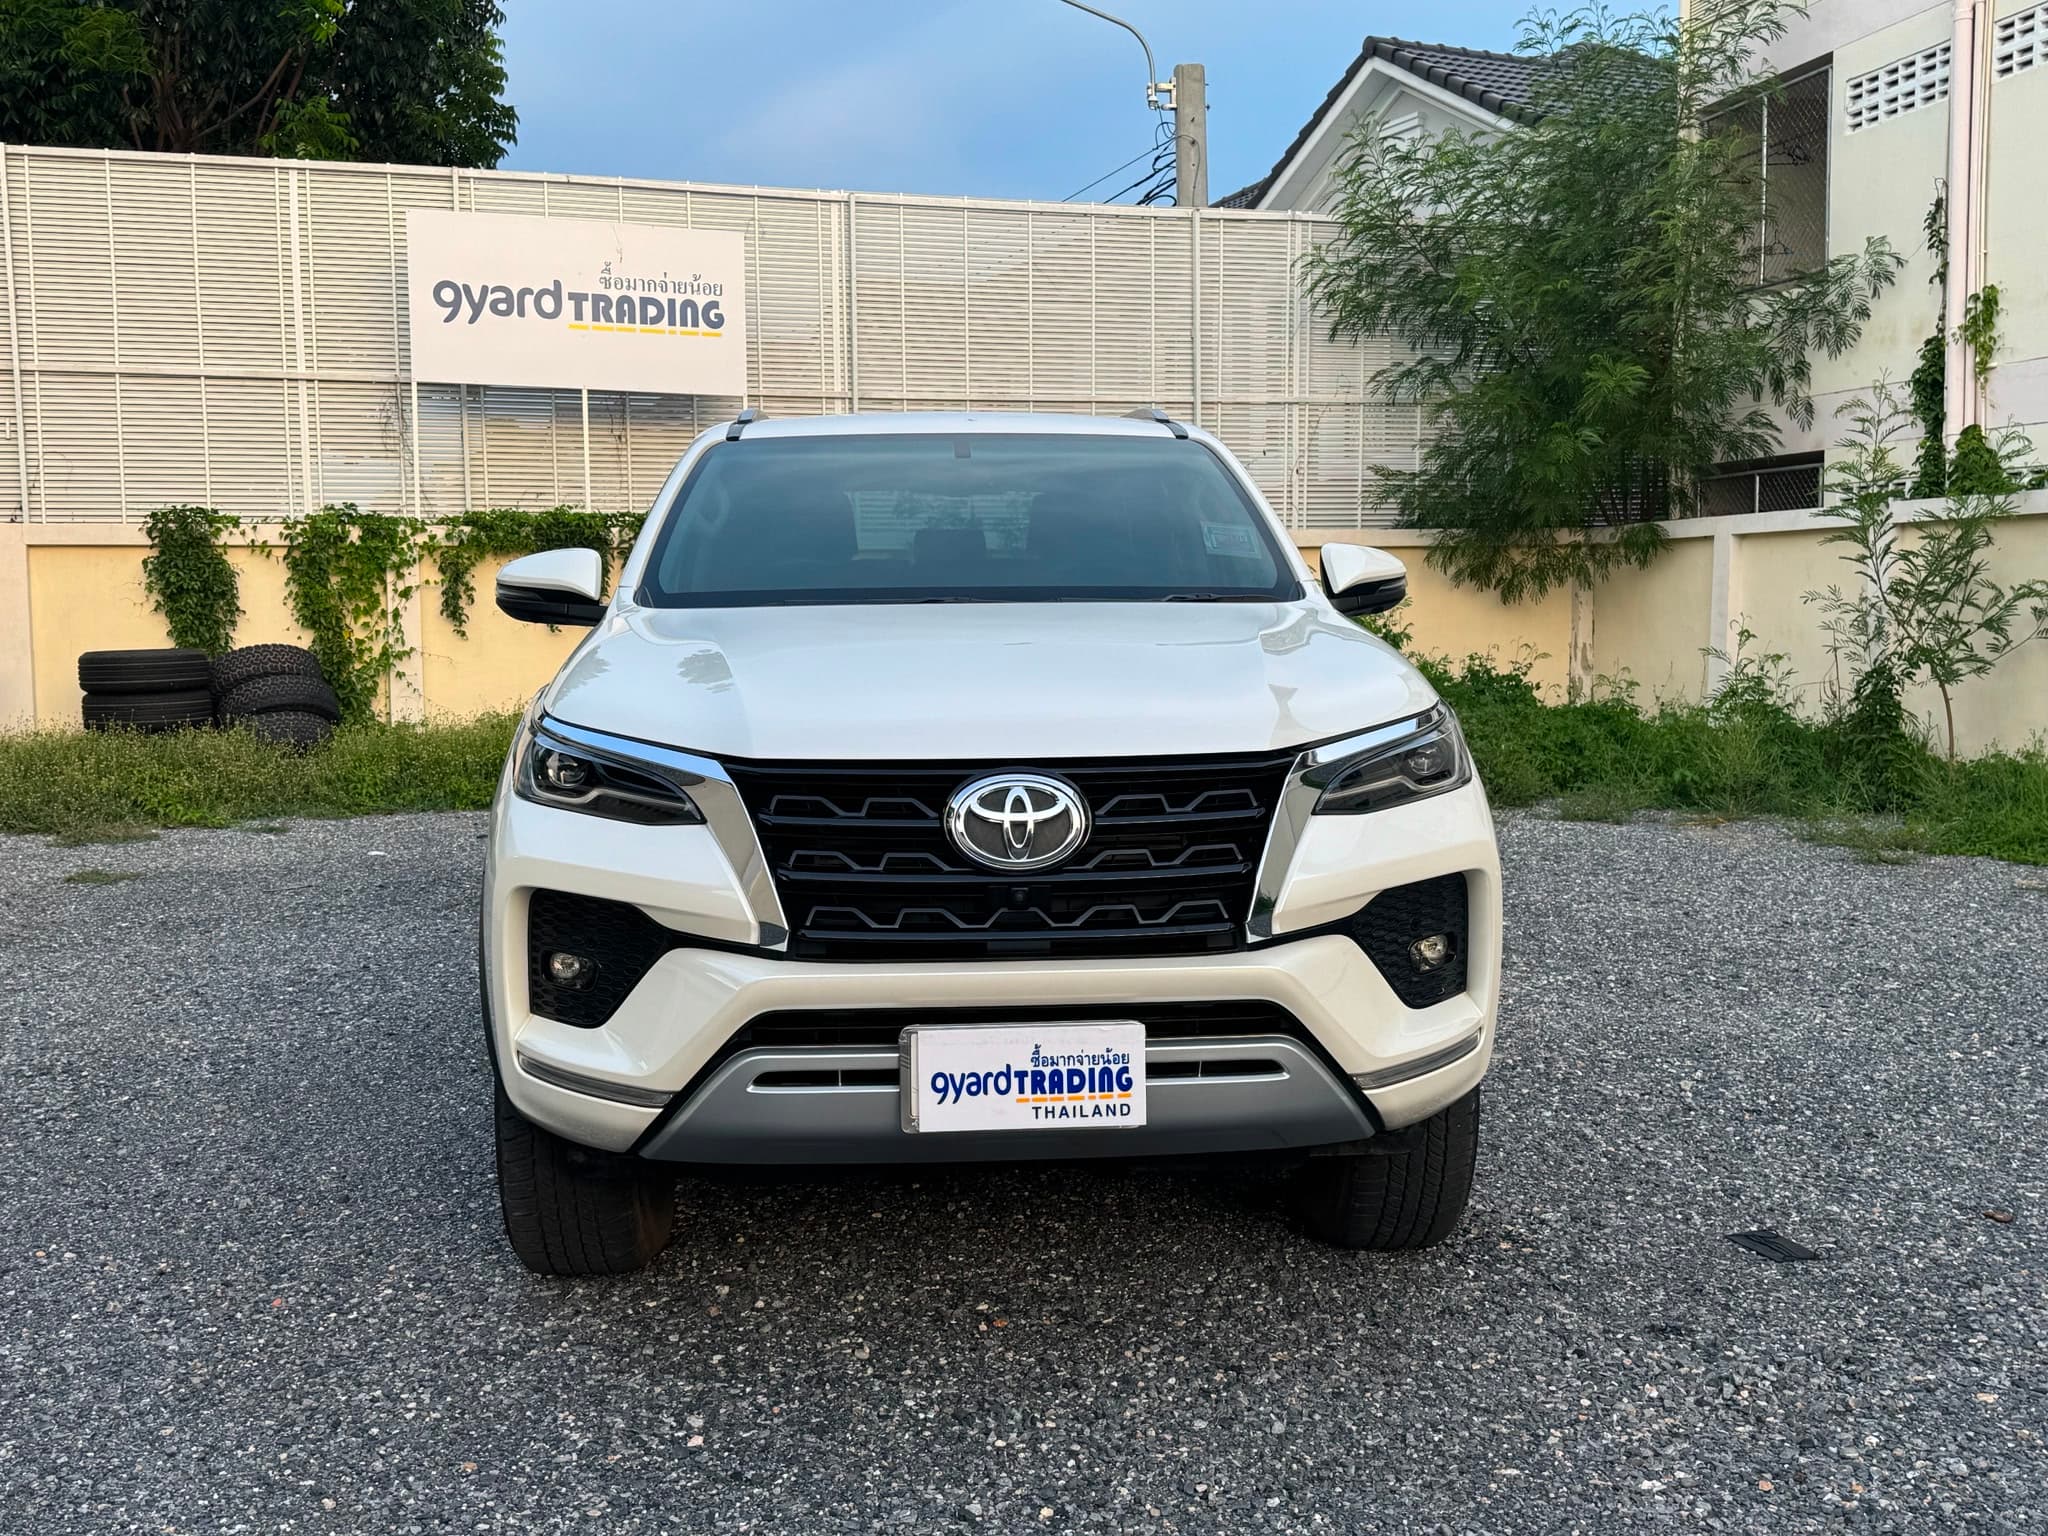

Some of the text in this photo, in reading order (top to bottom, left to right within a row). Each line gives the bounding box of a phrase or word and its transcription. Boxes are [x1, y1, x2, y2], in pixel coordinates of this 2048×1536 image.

[599, 261, 723, 297] ซื้อมากจ่ายน้อย
[432, 279, 725, 330] 9yard TRADING
[1030, 1043, 1130, 1068] ซื้อมากจ่ายน้อย
[931, 1063, 1133, 1105] 9yard TRADING
[1031, 1103, 1131, 1120] THAILAND
